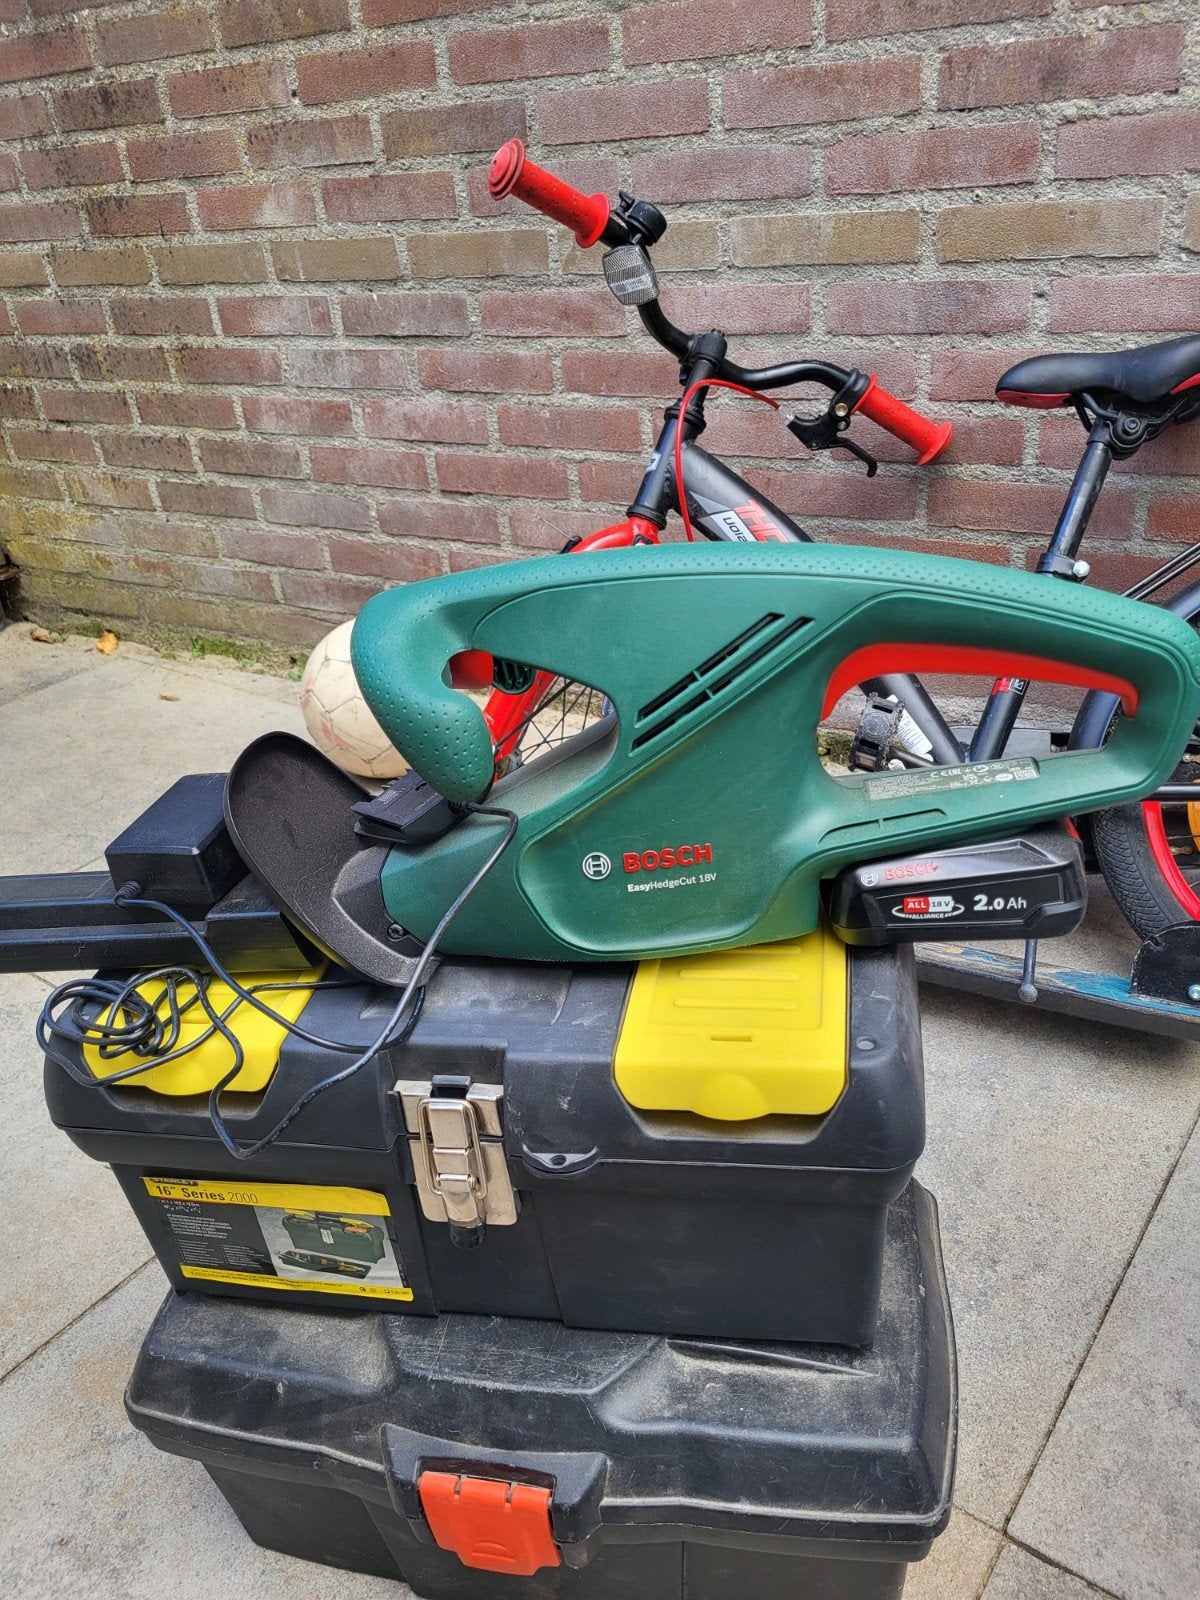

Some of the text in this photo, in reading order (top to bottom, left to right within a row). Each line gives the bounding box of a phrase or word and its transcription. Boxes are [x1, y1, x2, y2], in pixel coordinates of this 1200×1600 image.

[622, 842, 714, 873] BOSCH
[884, 861, 938, 881] BOSCH
[627, 873, 717, 893] EasyHedgeCut 18V
[907, 901, 927, 910] ALL
[943, 900, 951, 908] V
[973, 894, 1028, 911] 2.0 Ah
[912, 912, 945, 920] ALLIANCE
[181, 1187, 226, 1201] Series
[227, 1191, 259, 1204] 2000
